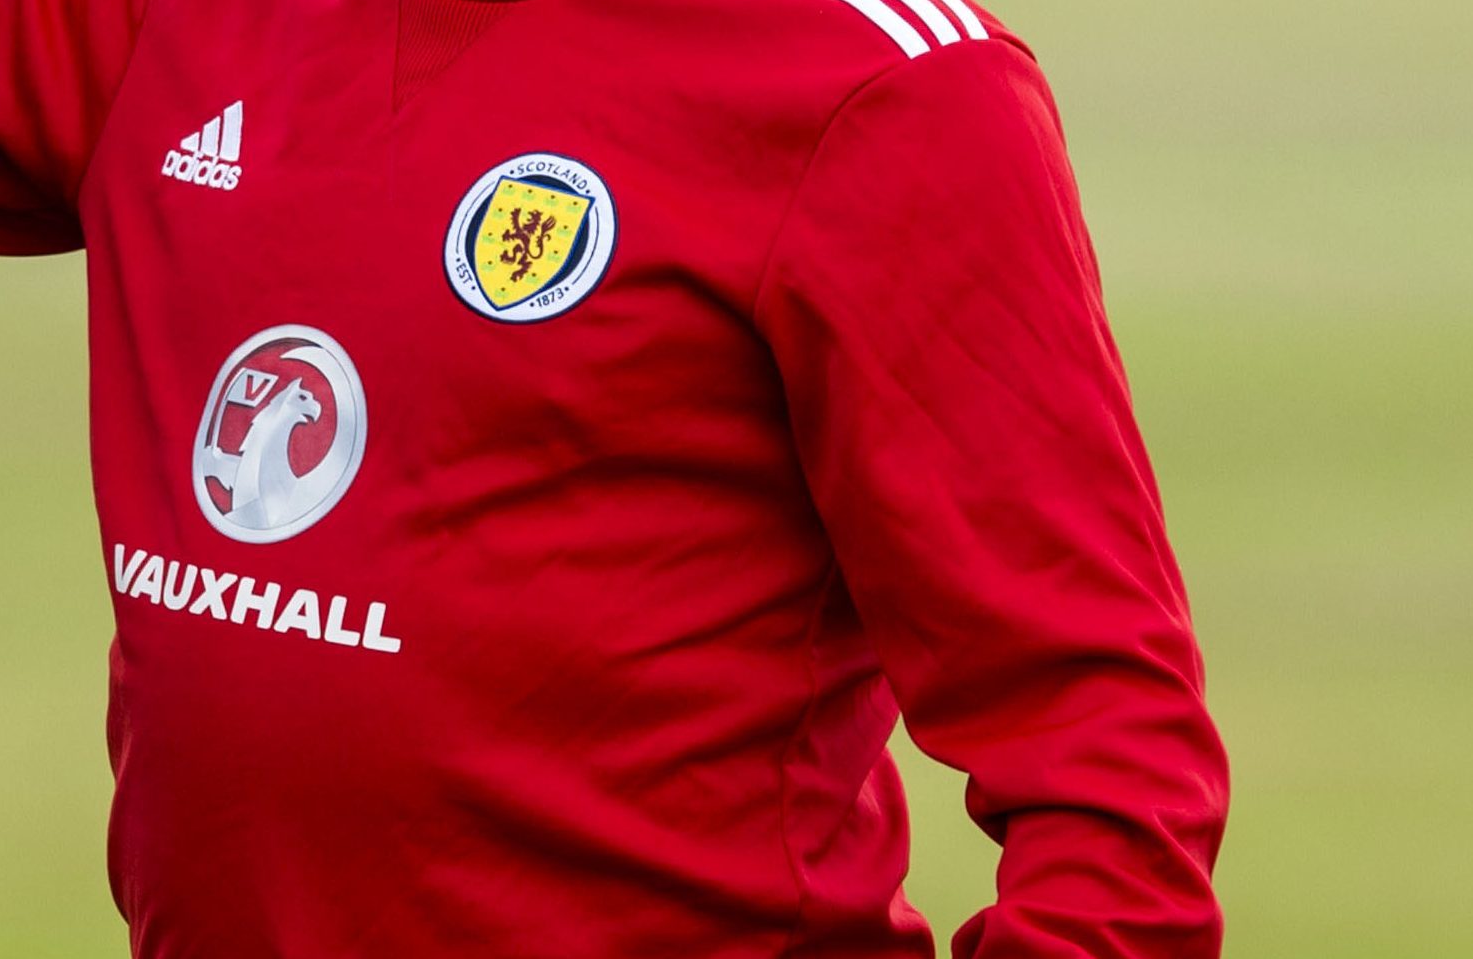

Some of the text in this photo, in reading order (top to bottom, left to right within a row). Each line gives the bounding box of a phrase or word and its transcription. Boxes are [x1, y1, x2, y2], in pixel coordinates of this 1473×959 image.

[161, 149, 243, 191] adidas
[517, 161, 587, 191] SCOTLAND
[455, 264, 473, 285] EST
[535, 287, 565, 308] 1873
[243, 373, 269, 403] V
[113, 543, 402, 654] VAUXHALL
